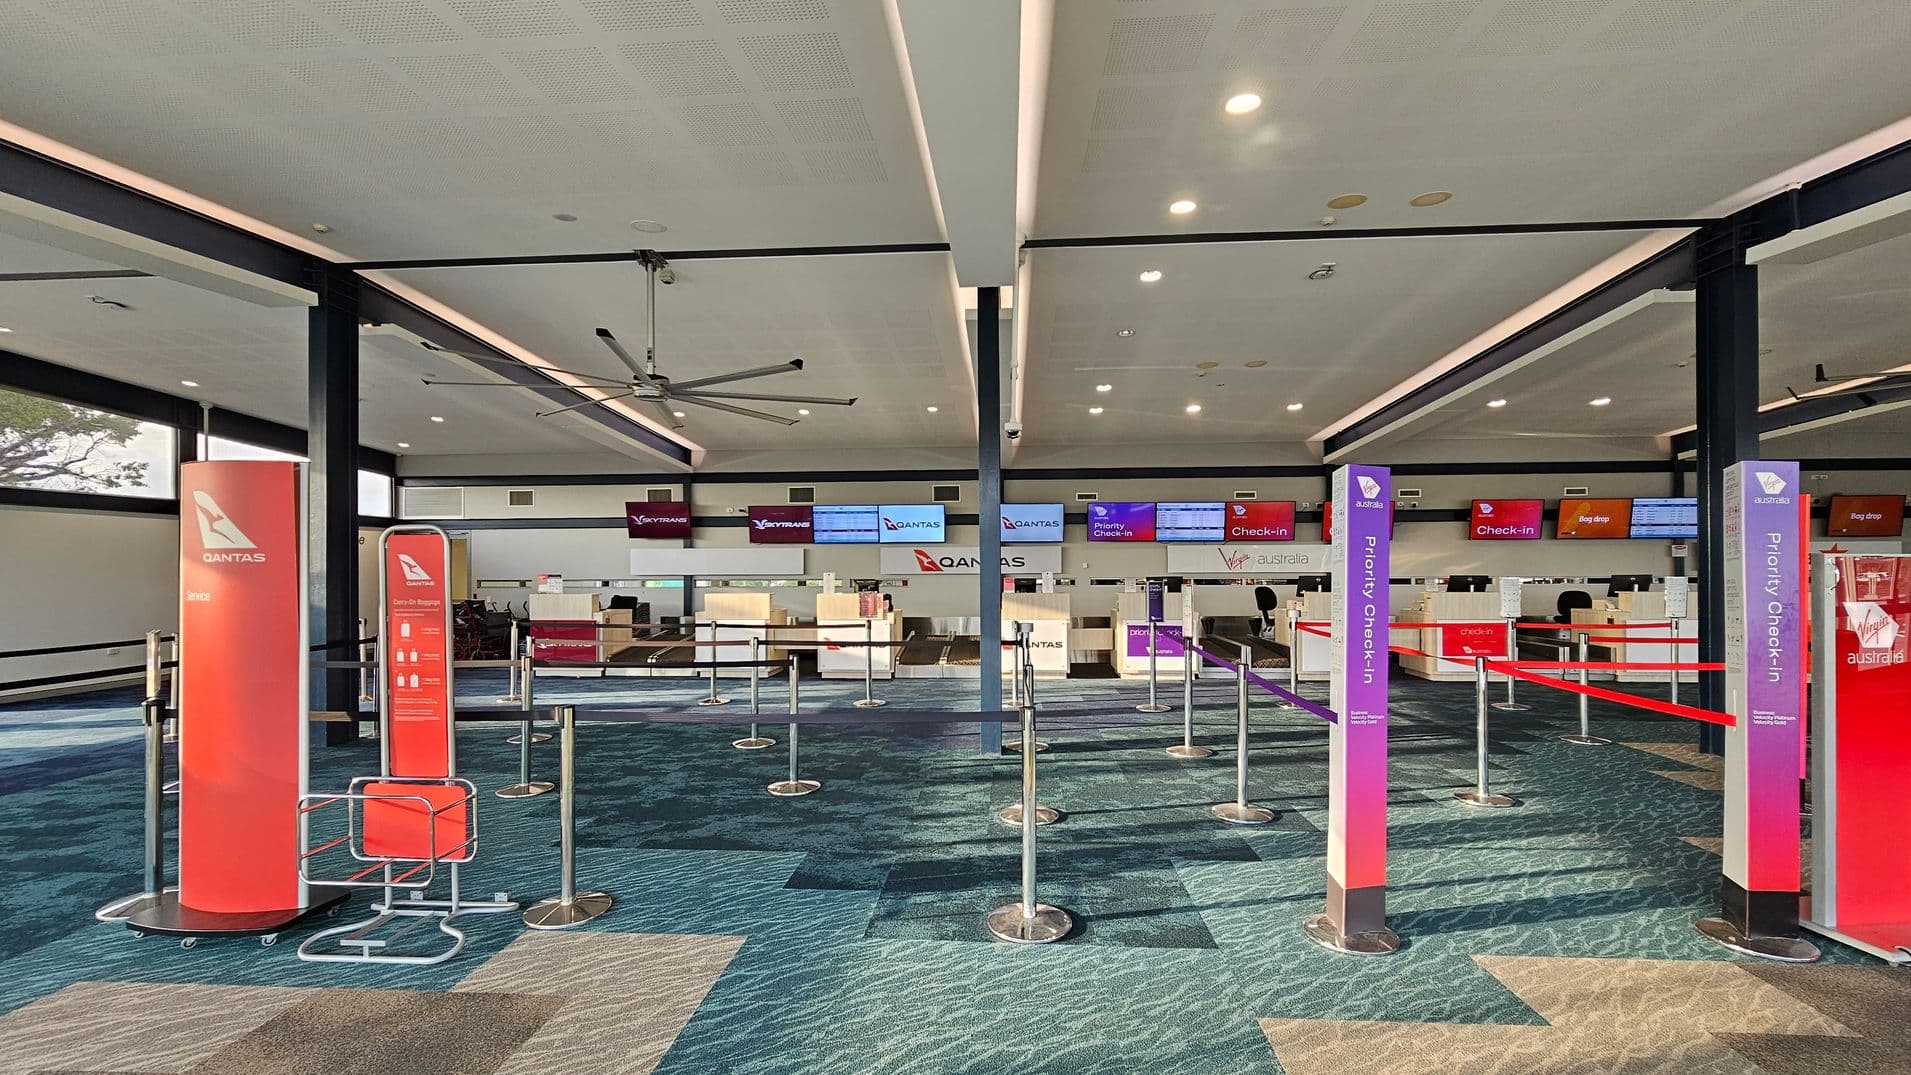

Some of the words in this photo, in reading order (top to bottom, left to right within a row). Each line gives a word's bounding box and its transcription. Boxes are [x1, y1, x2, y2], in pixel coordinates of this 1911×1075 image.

[1754, 496, 1790, 505] australia
[1014, 520, 1060, 528] QANTAS
[1579, 515, 1593, 523] Bag
[1594, 515, 1610, 523] drop
[1094, 522, 1125, 530] Priority
[1232, 526, 1288, 536] Check-in
[1477, 525, 1535, 535] Check-in
[203, 553, 266, 563] QANTAS
[939, 556, 1026, 568] QANAS
[1257, 552, 1309, 565] australia
[1362, 535, 1377, 600] Priority
[1764, 532, 1782, 597] Priority
[186, 590, 211, 602] Service
[1857, 608, 1891, 645] Virgin
[1363, 604, 1377, 684] Check-in
[1767, 602, 1783, 682] Check-in
[1847, 650, 1905, 665] australia
